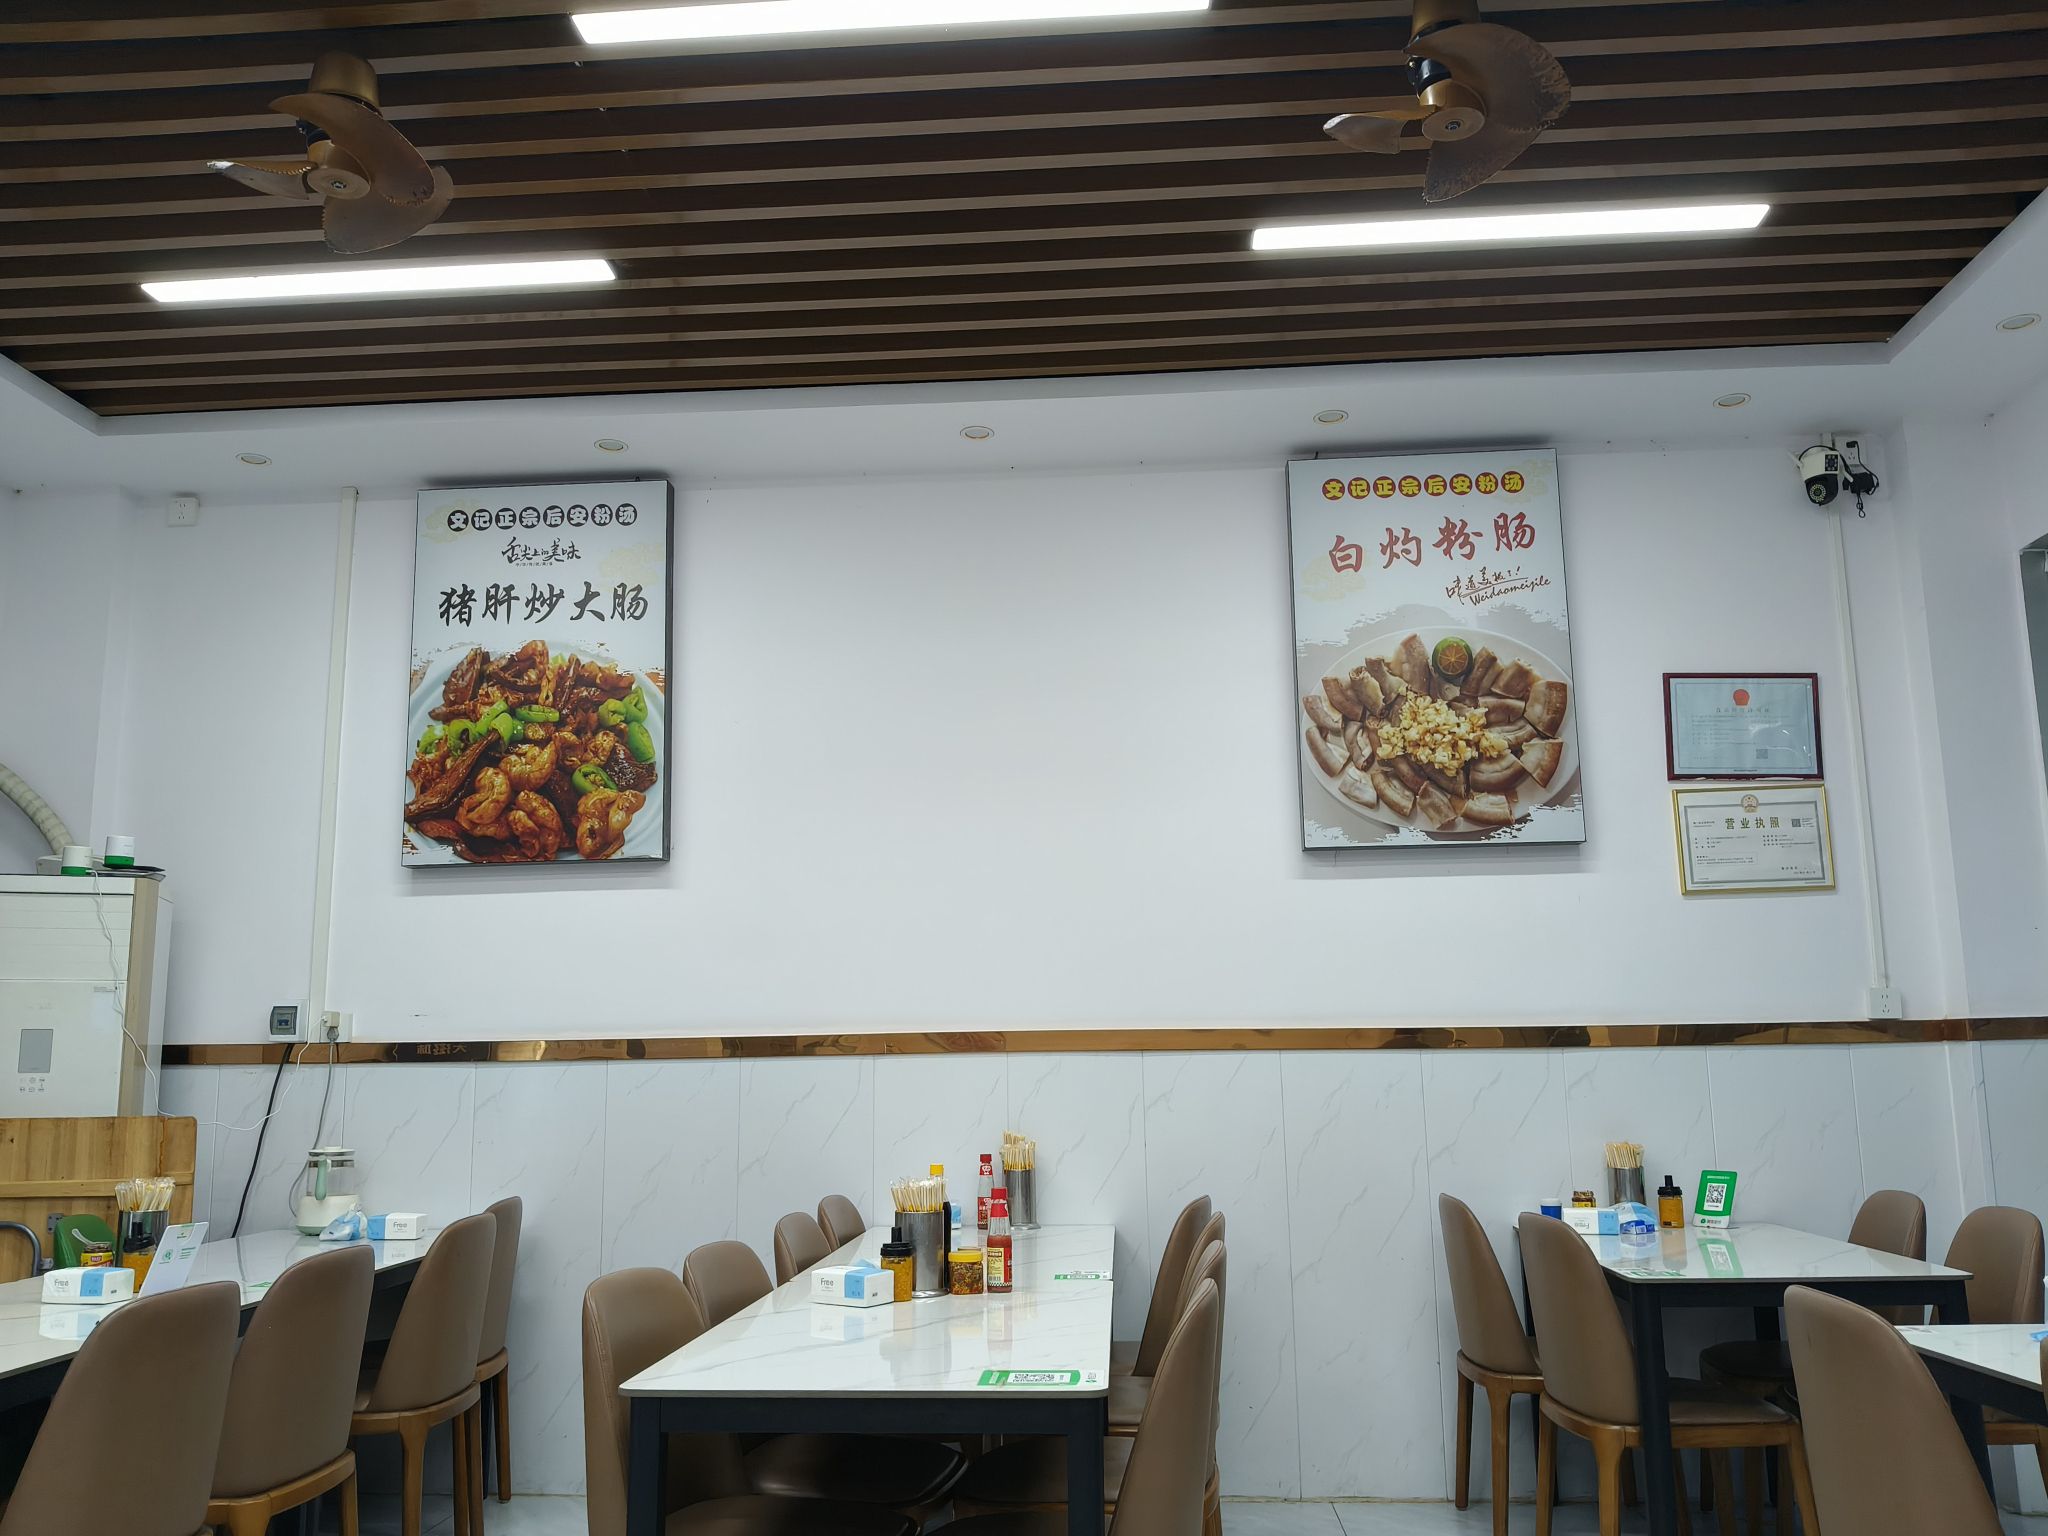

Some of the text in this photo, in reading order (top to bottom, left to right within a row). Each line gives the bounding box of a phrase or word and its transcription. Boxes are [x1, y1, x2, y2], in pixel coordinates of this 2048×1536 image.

[1322, 471, 1525, 500] 文记正宗后安粉汤
[448, 503, 638, 532] 文记正宗后安粉汤
[502, 536, 582, 564] 舌尖上的美味
[1328, 511, 1536, 574] 白灼粉肠
[439, 581, 649, 628] 猪肝炒大肠
[1724, 816, 1780, 830] 营业执照
[820, 1277, 834, 1287] Free
